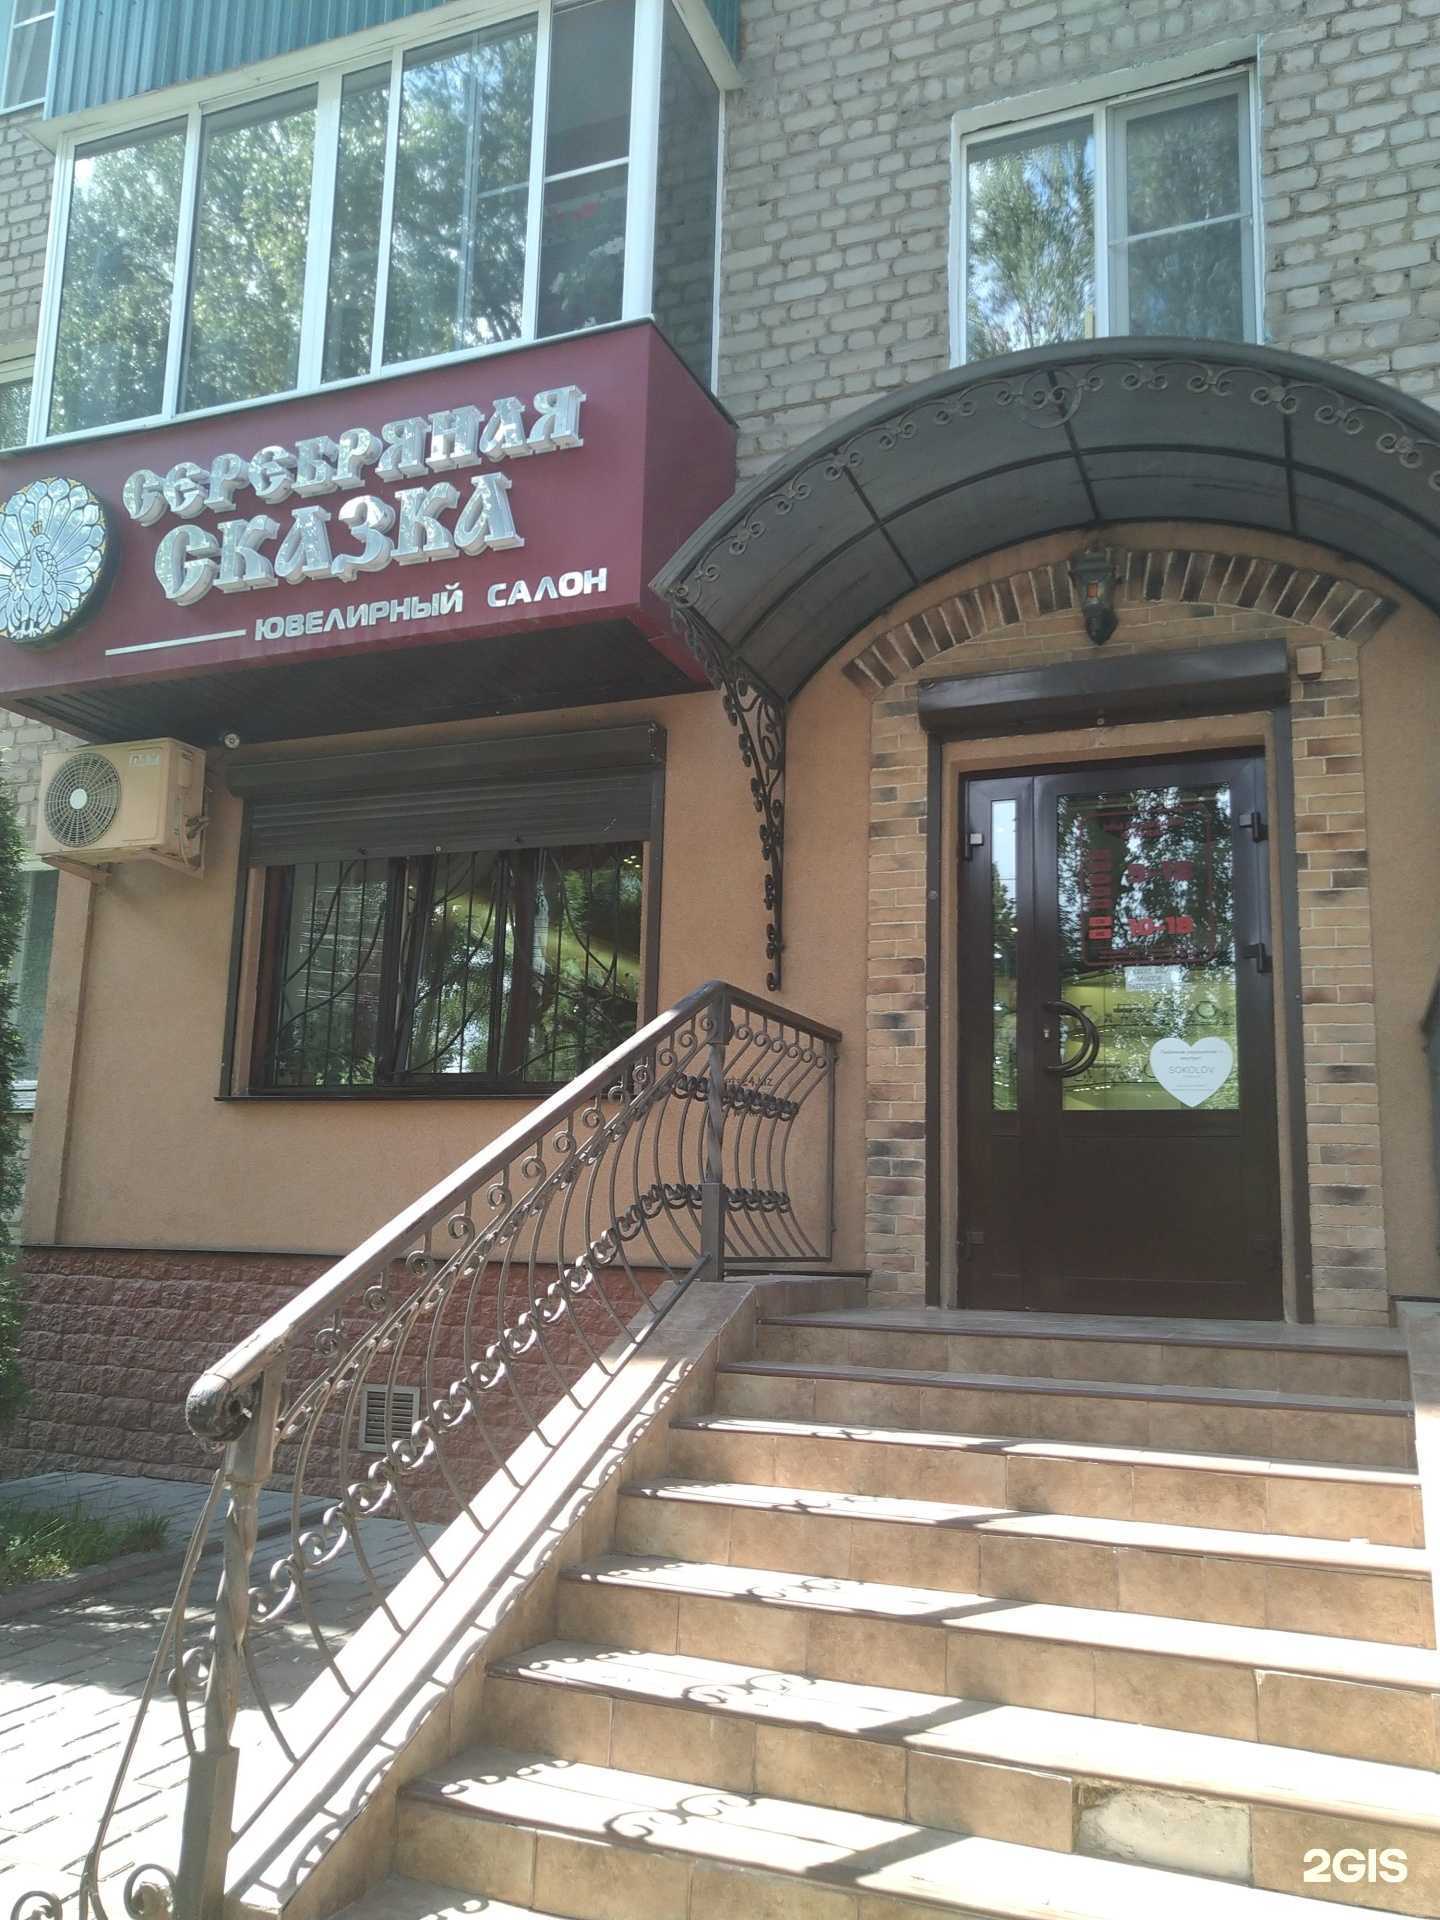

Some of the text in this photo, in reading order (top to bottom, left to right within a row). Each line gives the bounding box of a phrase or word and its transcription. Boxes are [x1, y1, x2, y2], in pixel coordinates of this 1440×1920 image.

[123, 384, 586, 527] СЕРЕБРЯНАЯ
[155, 471, 525, 606] СКАЗКА
[255, 568, 608, 642] ЮВЕЛИРНЫЙ САЛОН
